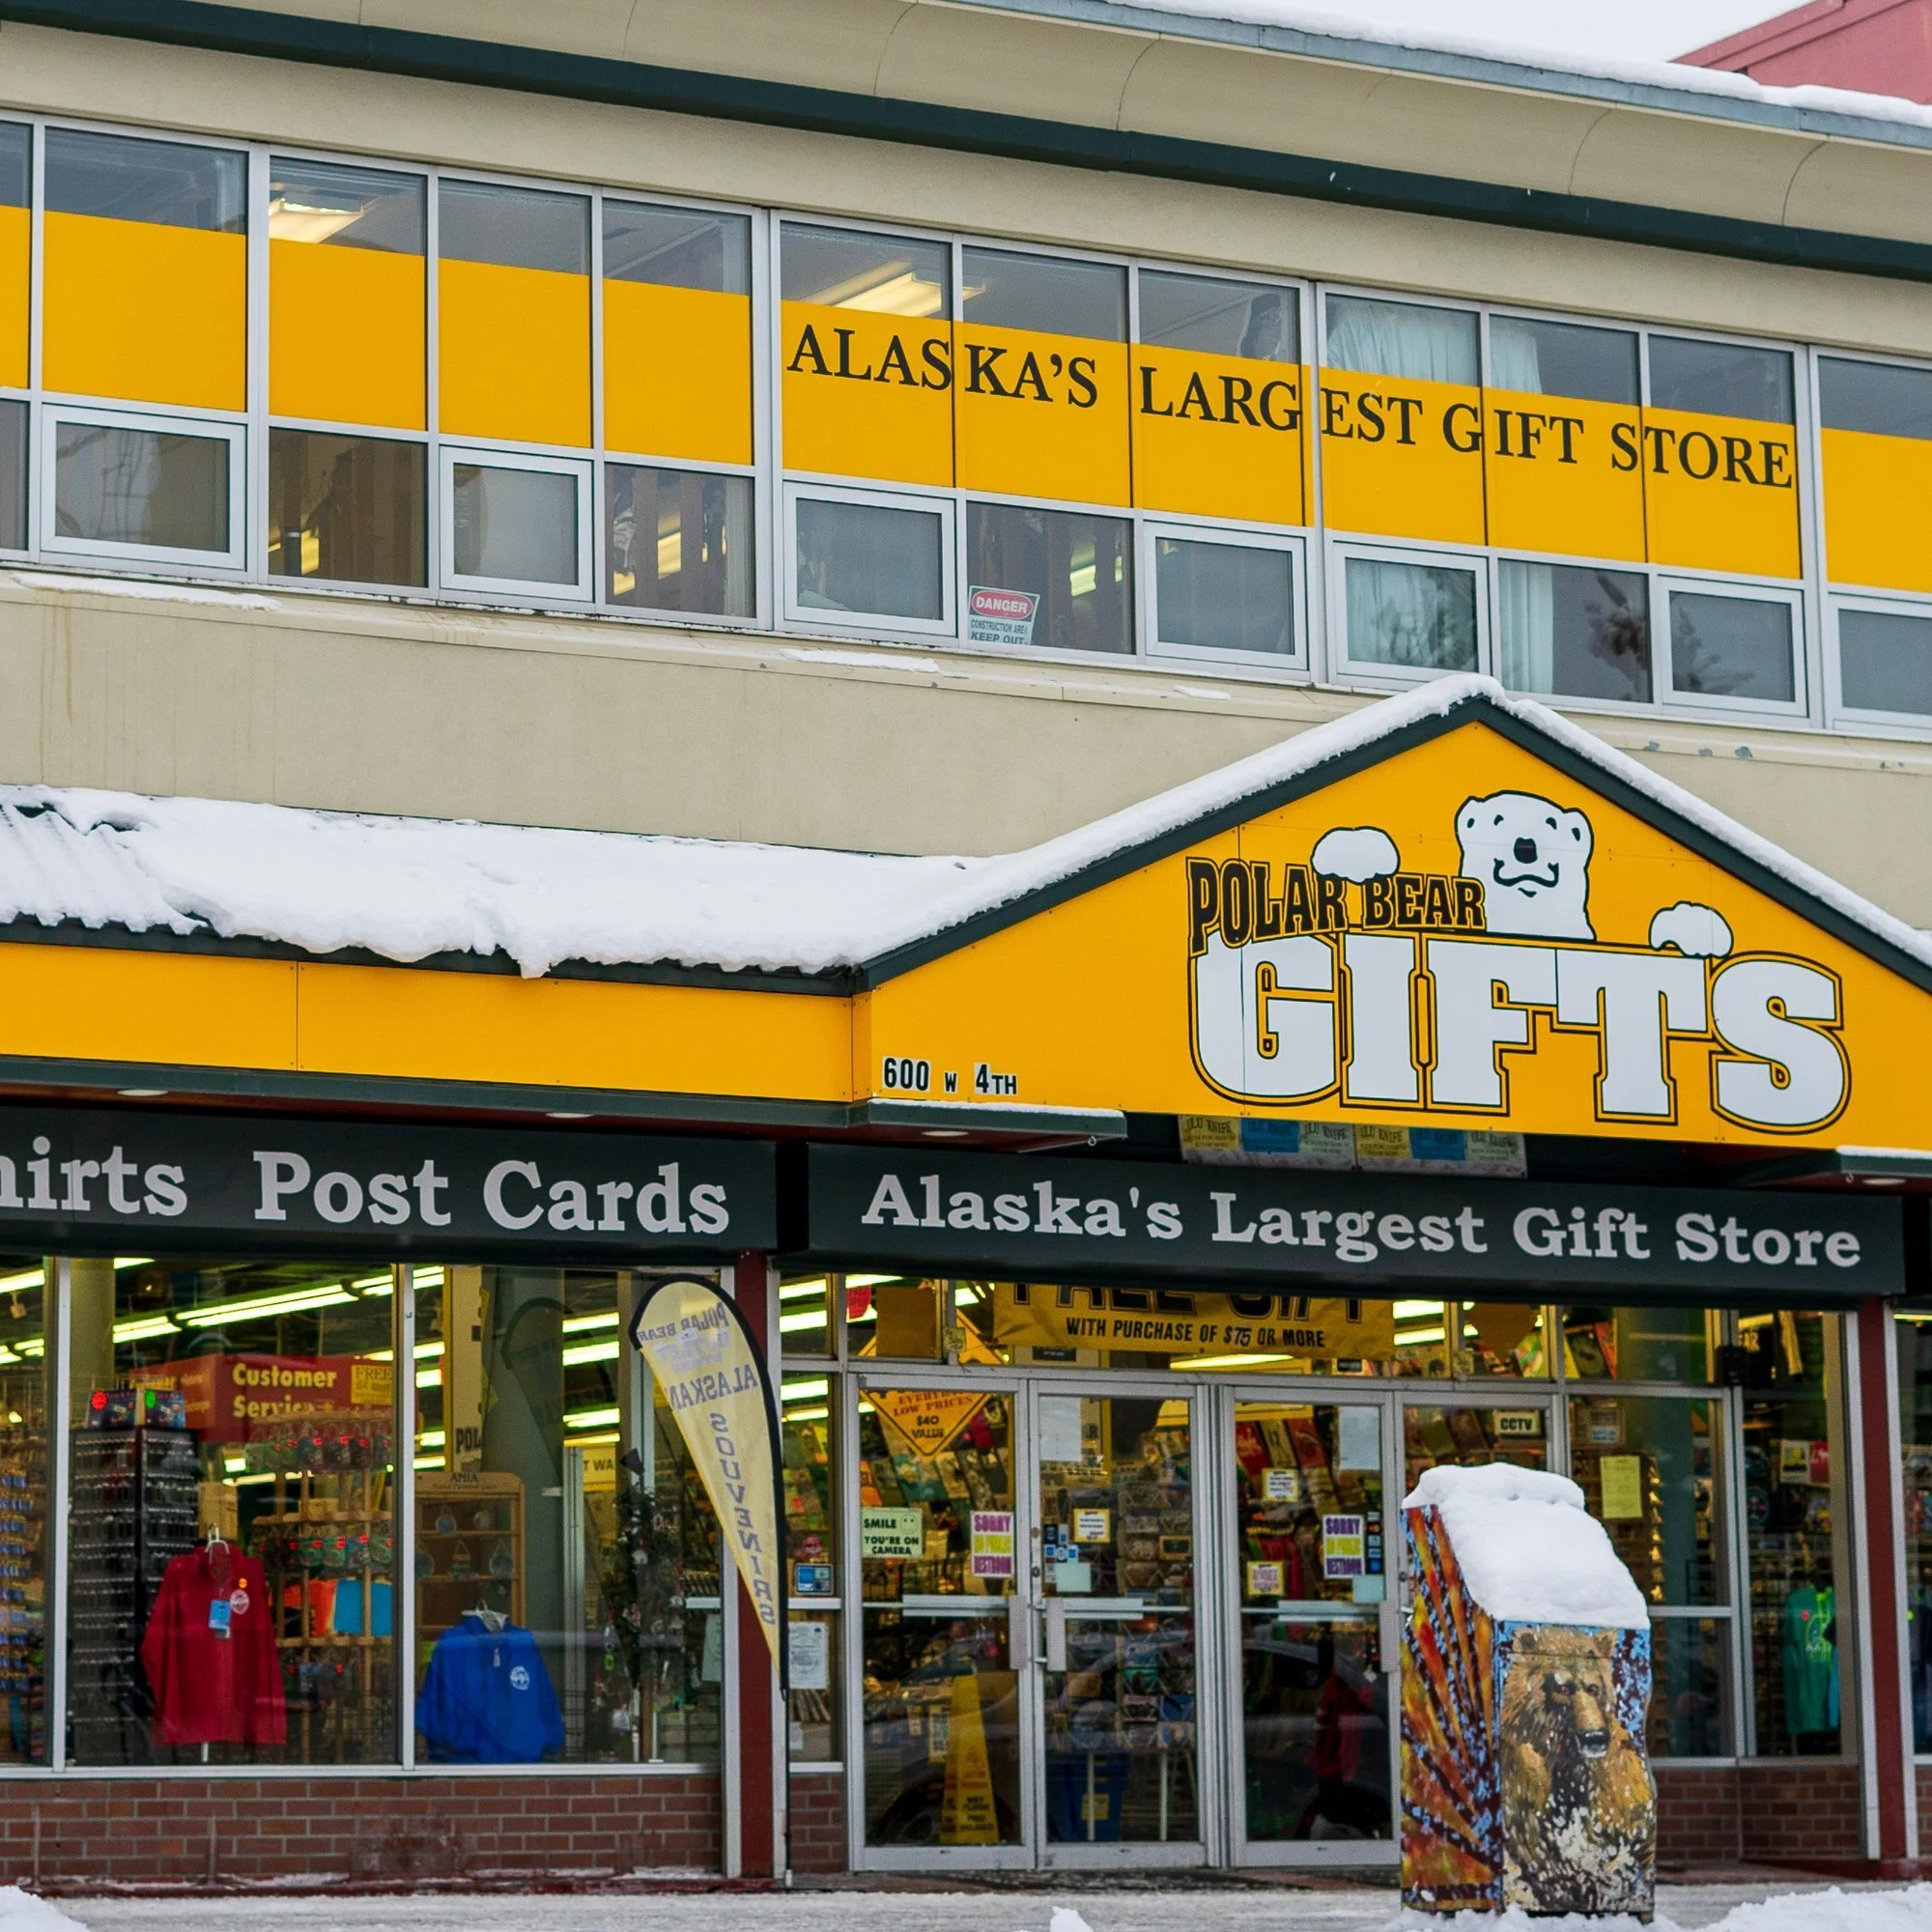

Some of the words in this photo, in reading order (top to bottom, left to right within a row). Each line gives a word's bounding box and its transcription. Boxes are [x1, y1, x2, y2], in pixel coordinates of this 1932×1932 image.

[787, 324, 1097, 409] ALASKA'S
[1140, 366, 1423, 445] LARGEST
[1442, 403, 1584, 464] GIFT
[1611, 422, 1793, 488] STORE
[976, 596, 1029, 613] DANGER
[970, 631, 1001, 642] KEEP
[1185, 857, 1349, 956] POLAR
[1363, 871, 1486, 931] BEAR
[1189, 931, 1851, 1134] GIFTS
[884, 1057, 929, 1092] 600
[944, 1072, 957, 1093] W
[976, 1064, 1017, 1094] 4TH
[253, 1151, 452, 1227] Post
[483, 1160, 729, 1235] Cards
[861, 1174, 1183, 1240] Alaska's
[1209, 1192, 1489, 1264] Largest
[1513, 1207, 1651, 1260] Gift
[1675, 1212, 1861, 1267] Store
[1065, 1317, 1106, 1336] WITH
[1113, 1320, 1193, 1341] PURCHASE
[1199, 1324, 1218, 1343] OF
[1223, 1325, 1252, 1347] $75
[1257, 1327, 1277, 1347] OR
[1282, 1329, 1325, 1349] MORE
[232, 1363, 337, 1388] Customer
[912, 1429, 946, 1439] VALUE
[1500, 1418, 1533, 1431] CCTV
[864, 1519, 897, 1529] SMILE
[865, 1535, 901, 1546] YOU'RE
[903, 1537, 920, 1546] ON
[871, 1546, 912, 1555] CAMERA
